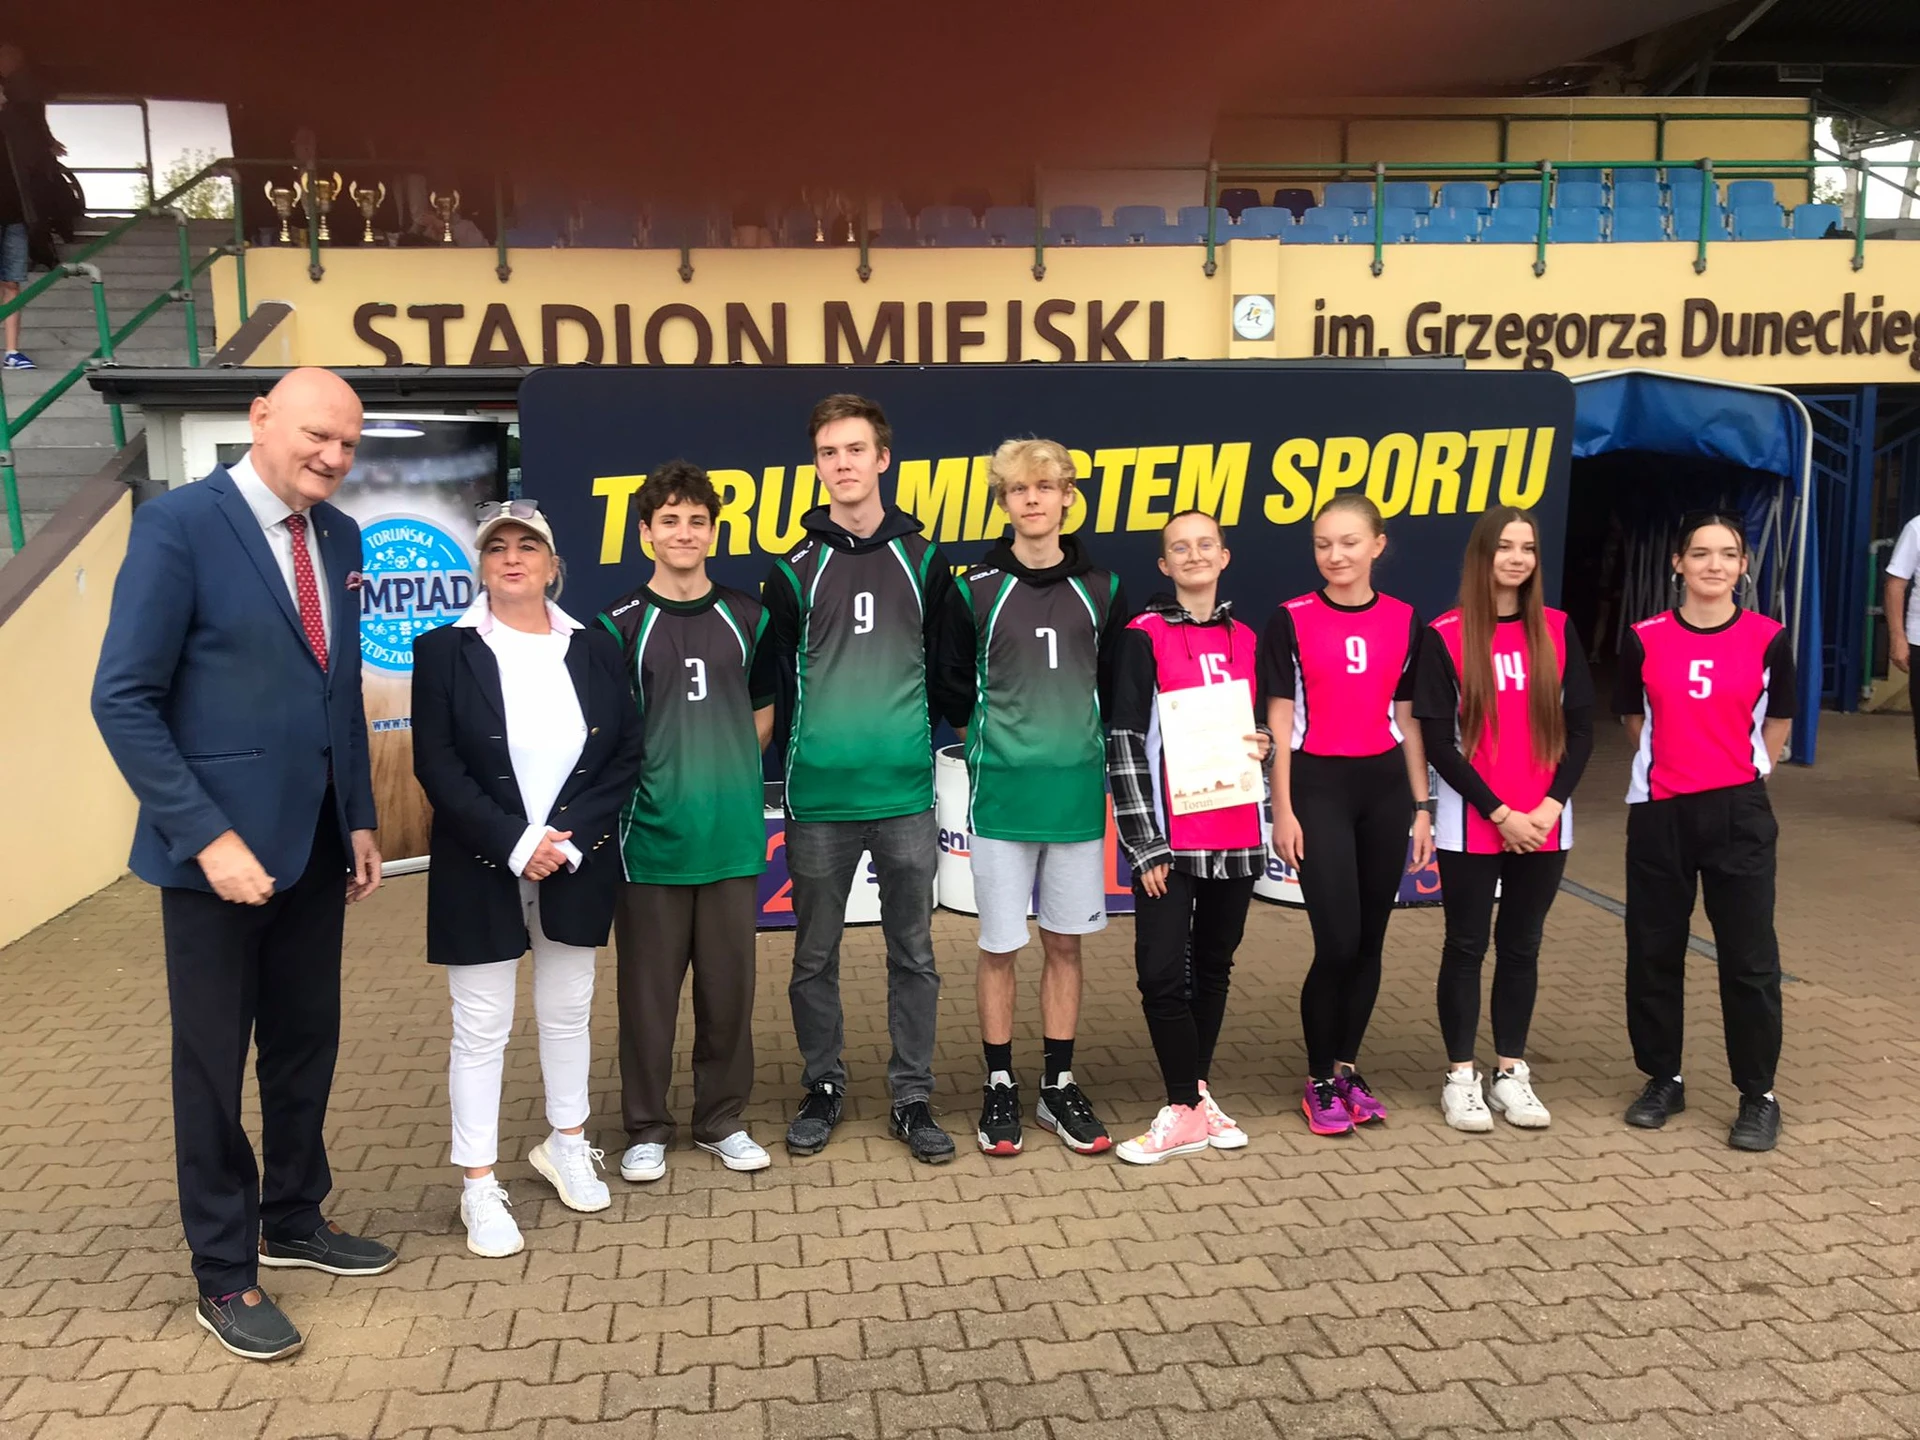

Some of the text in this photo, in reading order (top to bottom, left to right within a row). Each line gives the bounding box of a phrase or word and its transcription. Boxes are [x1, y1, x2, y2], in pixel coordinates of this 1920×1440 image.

[353, 299, 1165, 365] STADION MIEJSKI
[1313, 298, 1389, 357] im.
[1406, 301, 1667, 371] Grzegorza
[1263, 427, 1556, 524] SPORTU
[365, 525, 434, 549] TORUŃSKA
[854, 591, 875, 635] 9
[1035, 627, 1058, 669] 7
[1345, 635, 1367, 674] 9
[684, 657, 708, 701] 3
[1199, 653, 1232, 688] 15
[1494, 651, 1526, 691] 14
[1688, 659, 1714, 699] 5
